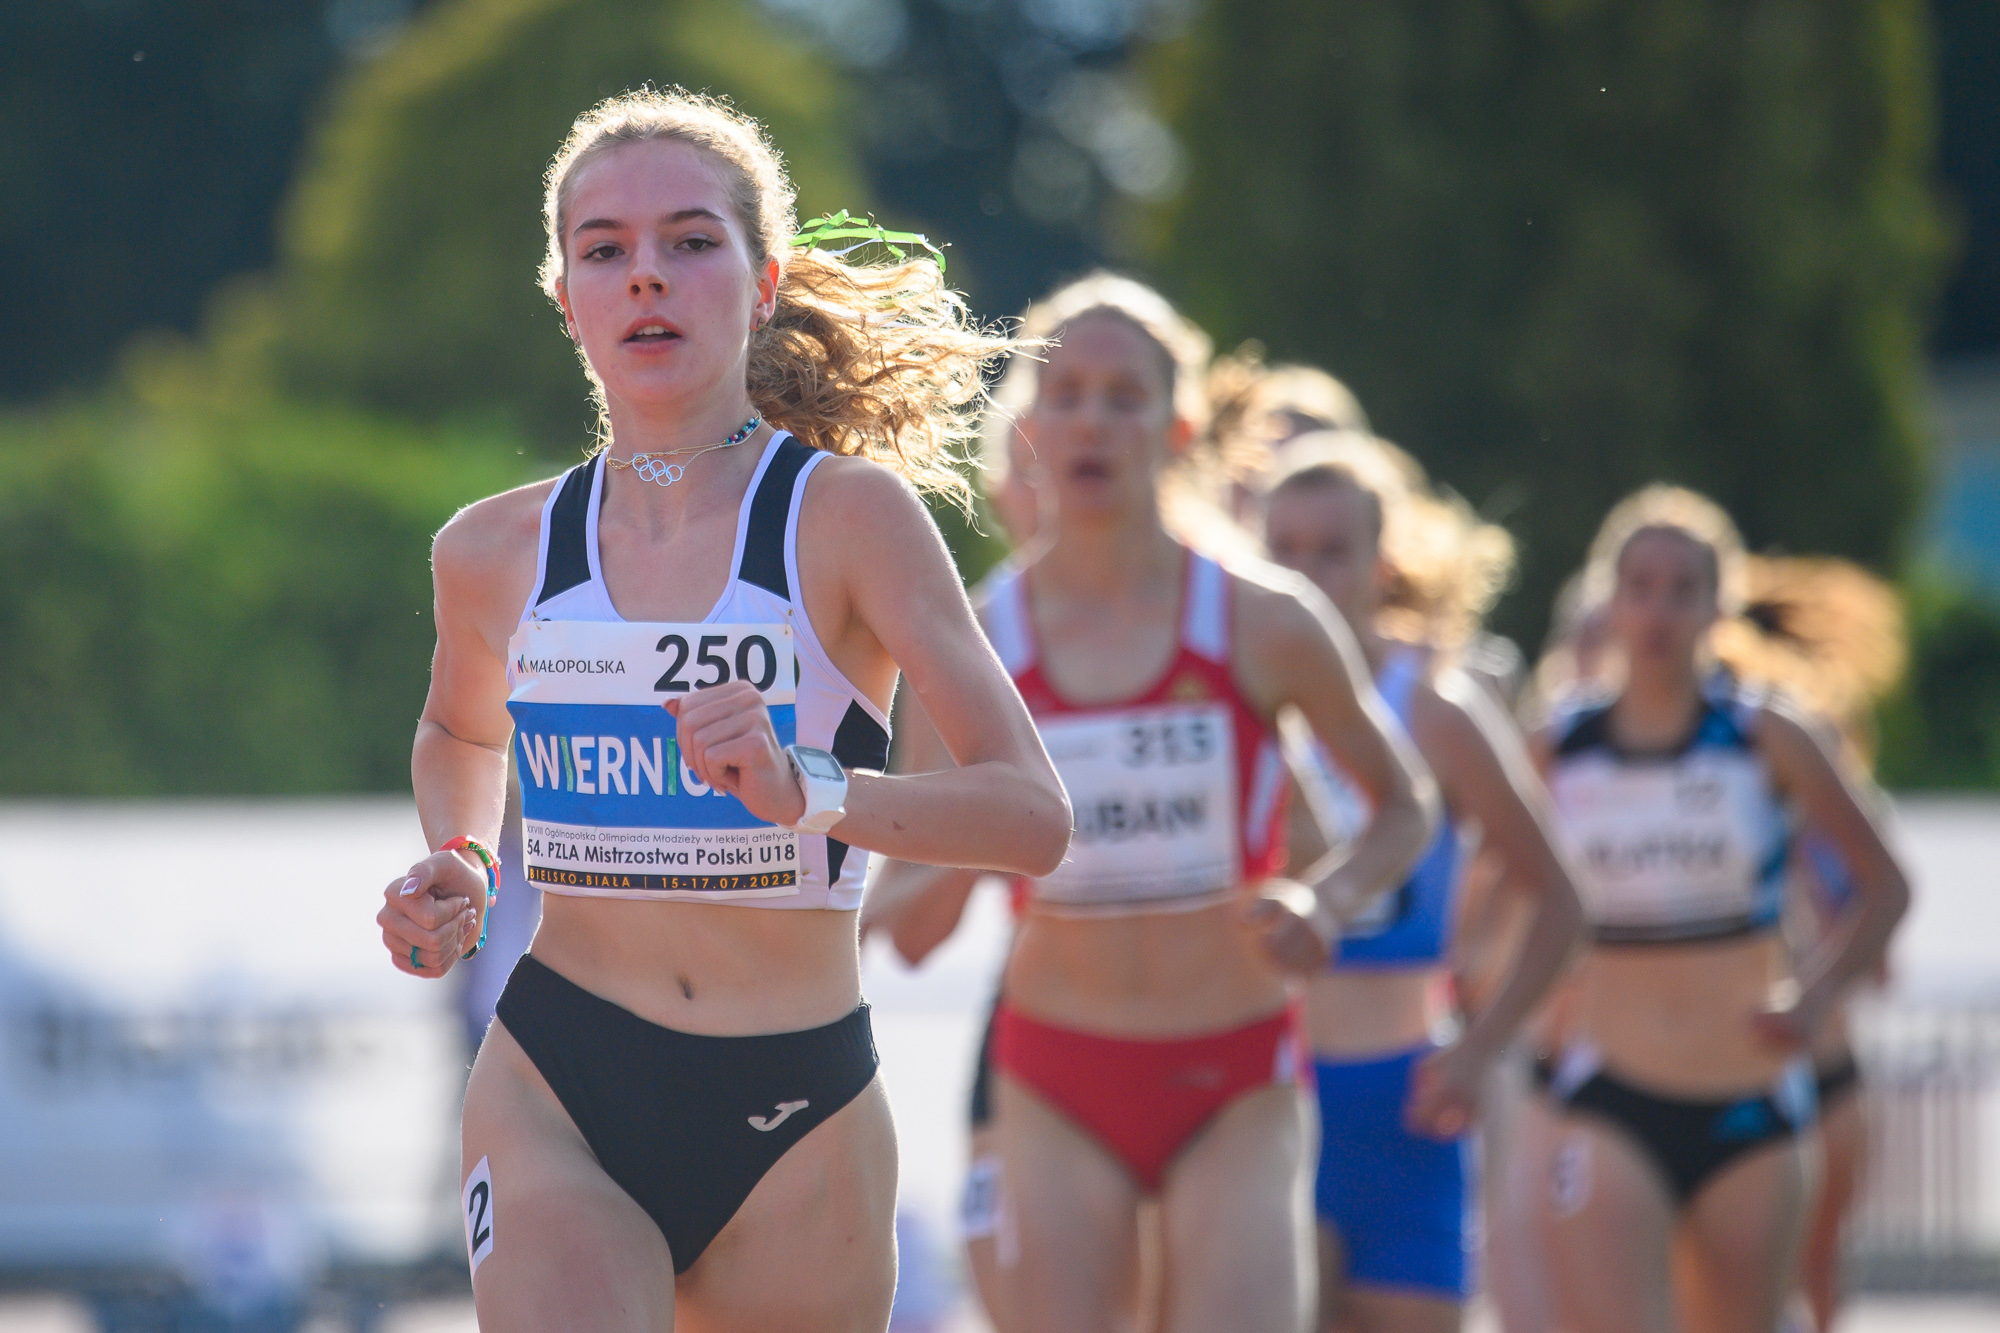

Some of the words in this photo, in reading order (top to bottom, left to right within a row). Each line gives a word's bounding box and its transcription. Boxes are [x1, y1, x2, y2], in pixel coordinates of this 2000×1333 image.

[529, 659, 626, 674] MAŁOPOLSKA
[653, 634, 778, 693] 250
[544, 827, 596, 841] Ogólnopolska
[598, 833, 650, 844] Olimpiada
[652, 834, 702, 845] Młodzieży
[703, 836, 713, 844] w
[715, 835, 750, 845] lekkiej
[751, 831, 796, 844] atletyce
[526, 838, 544, 857] 54.
[547, 841, 580, 862] PZLA
[584, 844, 689, 866] Mistrzostwa
[695, 848, 753, 866] Polski
[759, 843, 796, 864] U18
[529, 867, 631, 888] BIELSKO-BIAŁA
[661, 872, 791, 890] 15-17.07.2022
[468, 1181, 490, 1259] 2
